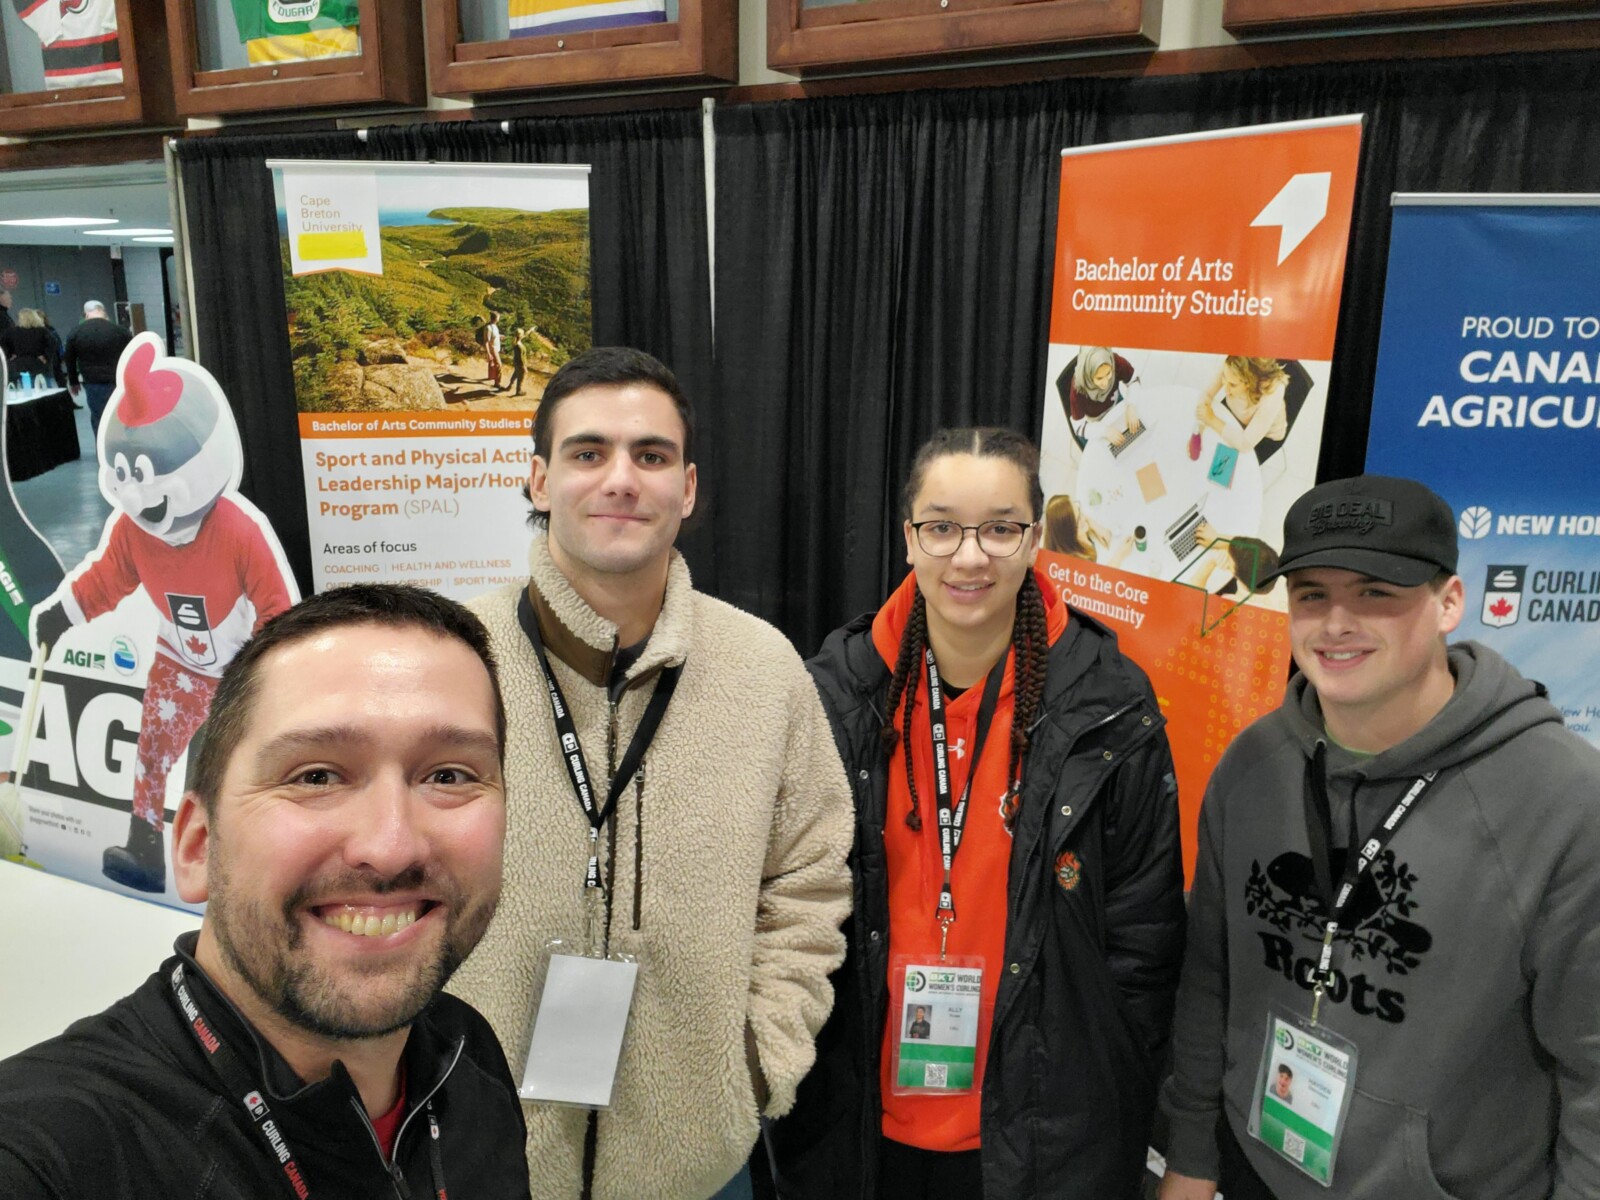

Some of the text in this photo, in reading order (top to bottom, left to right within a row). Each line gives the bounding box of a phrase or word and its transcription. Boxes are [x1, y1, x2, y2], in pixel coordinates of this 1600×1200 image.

[300, 195, 330, 207] Cape
[301, 208, 340, 219] Breton
[302, 220, 363, 233] University
[1074, 256, 1233, 282] Bachelor of Arts
[1072, 288, 1273, 320] Community Studies
[1461, 316, 1600, 340] PROUD TO
[1417, 395, 1600, 429] AGRICU
[312, 420, 364, 432] Bachelor
[366, 419, 379, 431] of
[381, 420, 407, 431] Arts
[409, 418, 477, 432] Community
[479, 418, 521, 430] Studies
[316, 452, 367, 472] Sport
[372, 449, 406, 466] and
[412, 448, 487, 470] Physical
[318, 474, 422, 494] Leadership
[320, 498, 460, 521] Program (SPAL)
[1497, 515, 1555, 536] NEW
[323, 540, 418, 555] Areas of focus
[324, 559, 512, 574] COACHING HEALTH AND WELLNESS
[453, 577, 486, 586] SPORT
[1049, 562, 1149, 604] Get to the Core
[1062, 588, 1146, 630] Community
[63, 648, 92, 668] AGI
[930, 664, 941, 711] CURLING CANADA
[550, 691, 566, 719] CANADA
[936, 743, 948, 795] CURLING CANADA
[570, 754, 593, 812] CURLING CANADA
[942, 828, 952, 854] CURLING
[957, 974, 981, 984] WORLD
[1257, 931, 1405, 1024] Roots
[177, 984, 221, 1054] CURLING CANADA
[262, 1120, 310, 1200] CURLING CANADA
